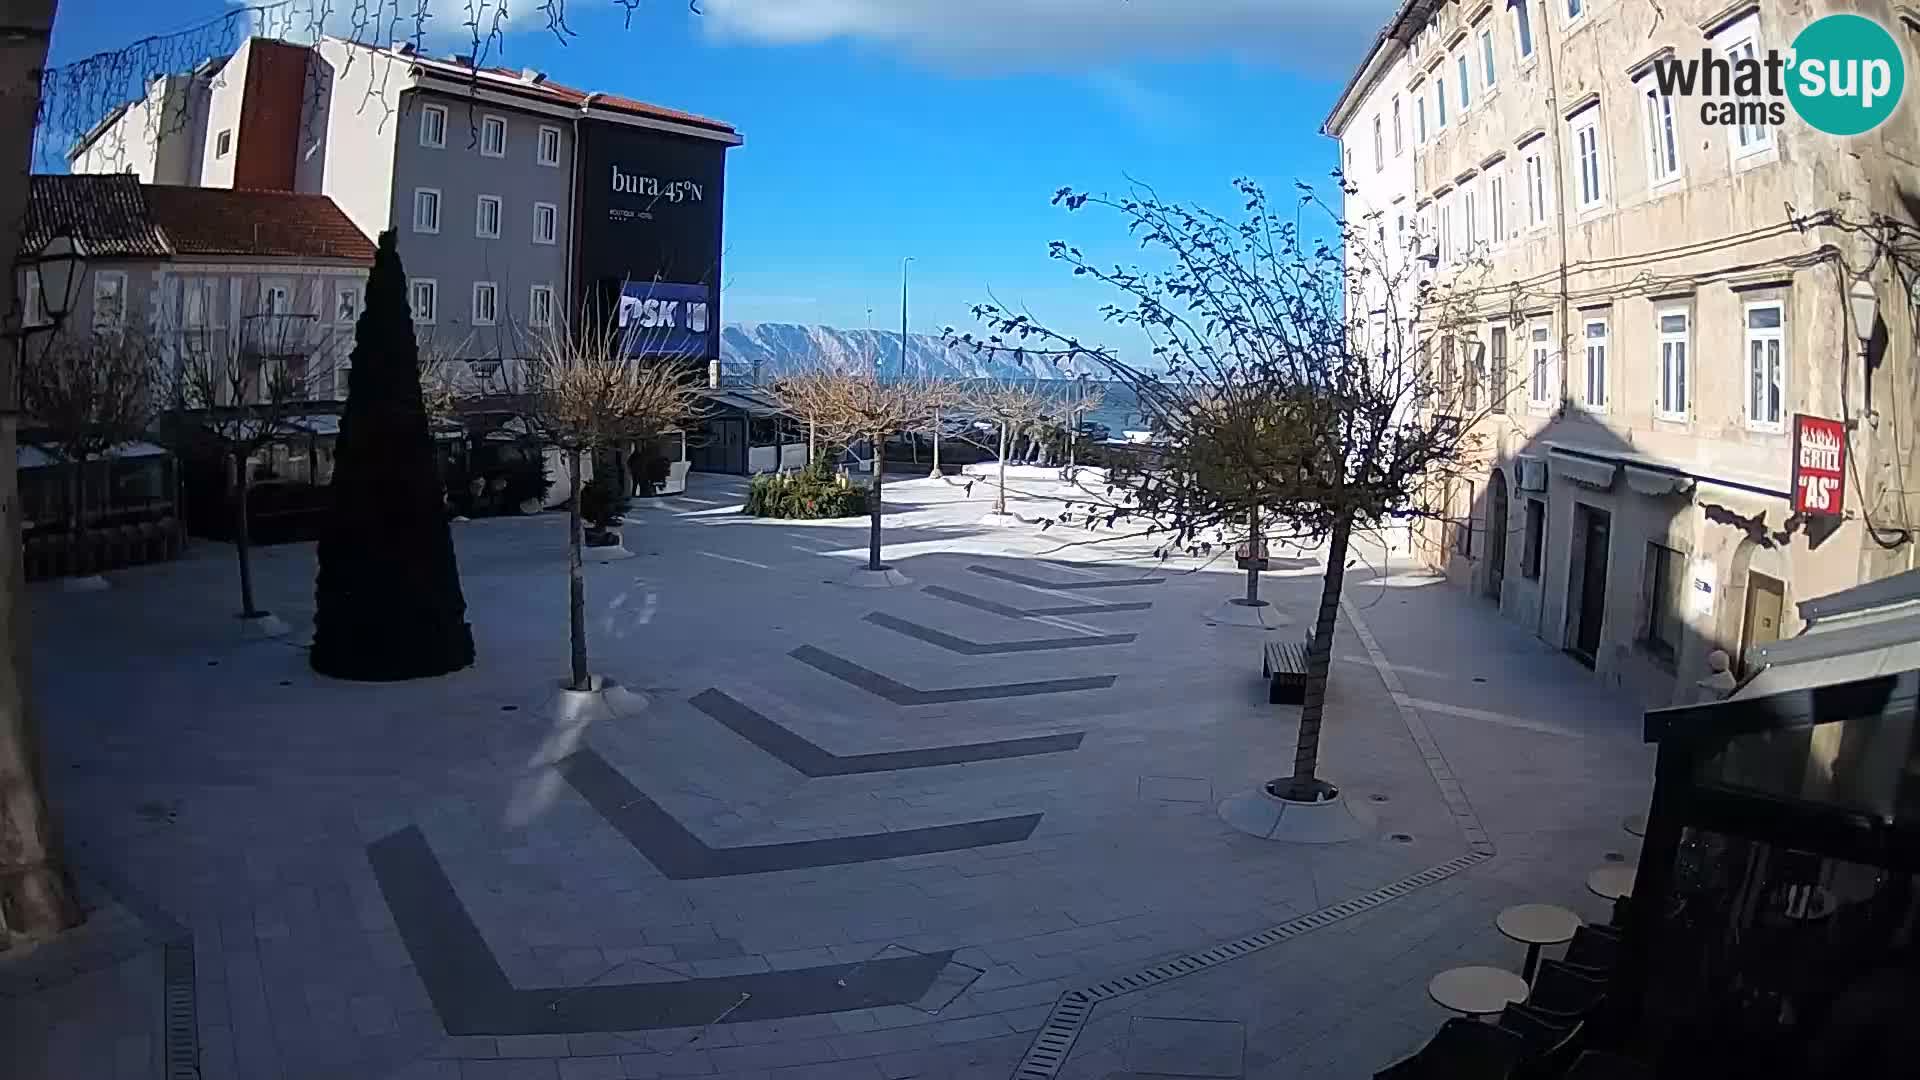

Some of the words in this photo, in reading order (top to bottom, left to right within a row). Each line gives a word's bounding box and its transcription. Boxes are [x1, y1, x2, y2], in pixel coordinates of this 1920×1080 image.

[612, 165, 658, 196] bura
[618, 295, 679, 328] PSK
[1800, 448, 1841, 472] GRILL
